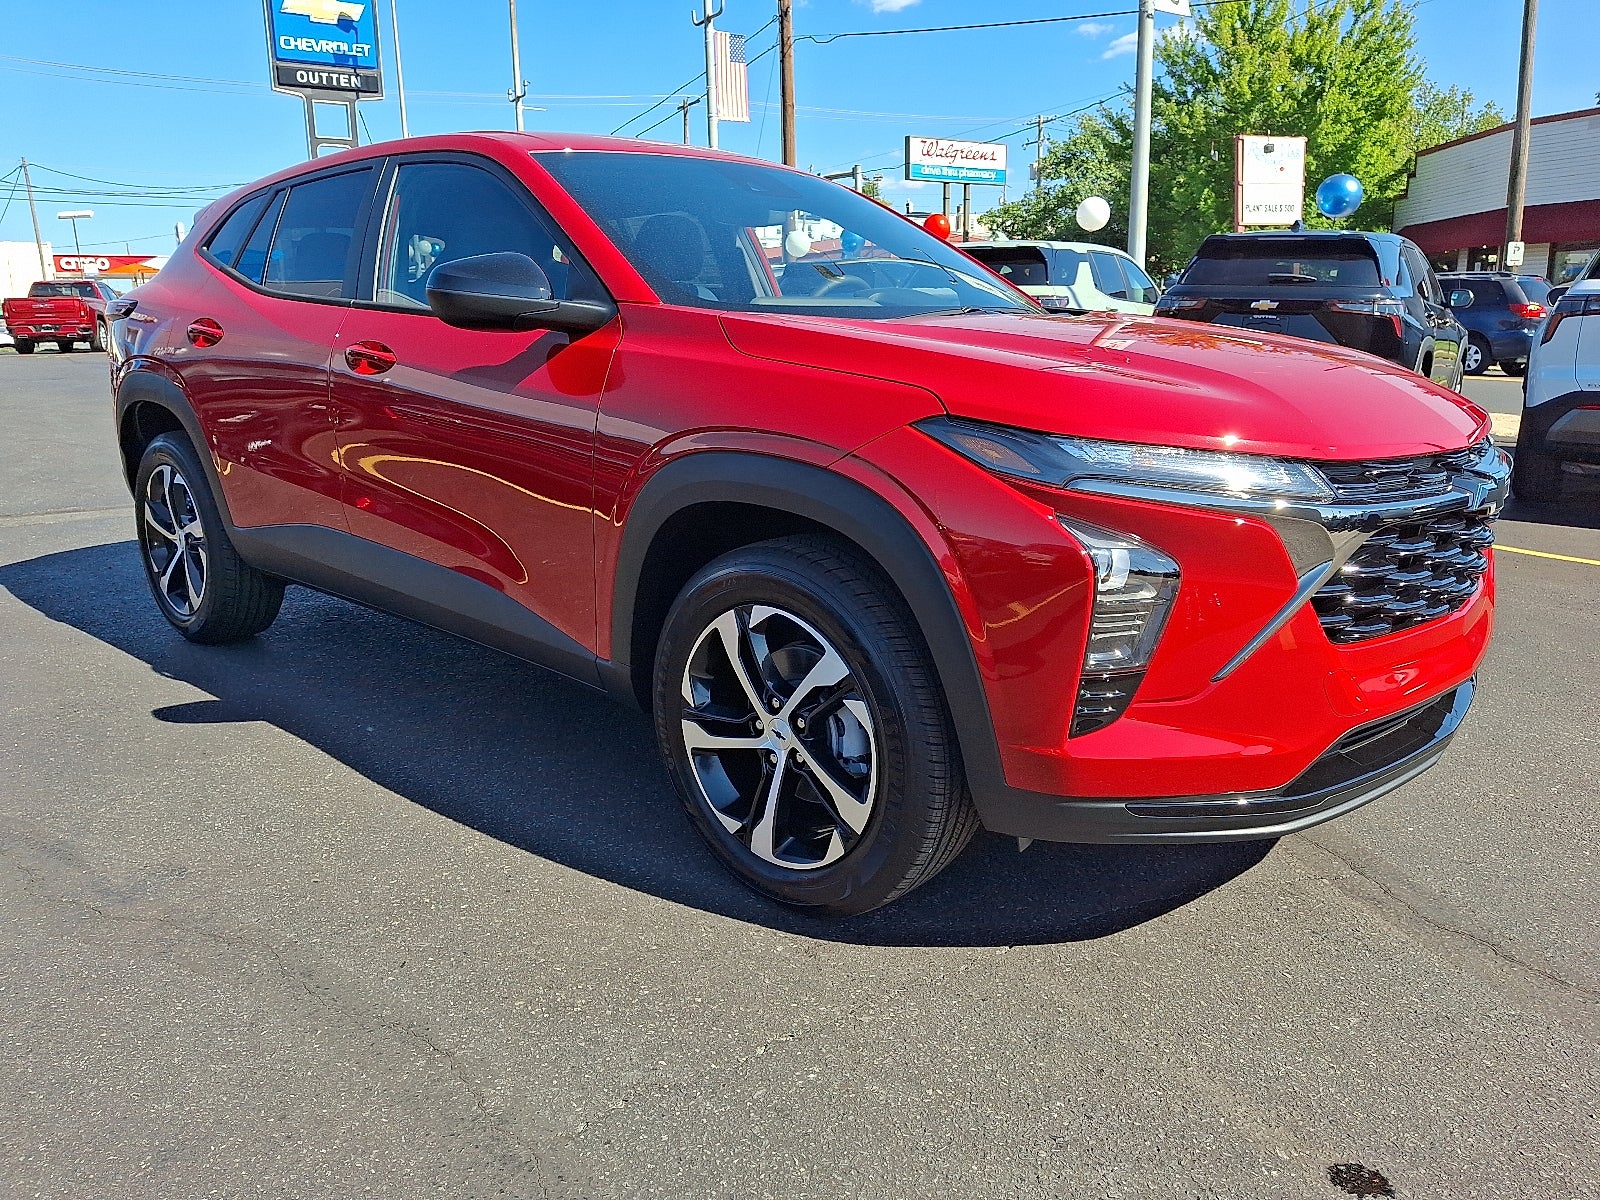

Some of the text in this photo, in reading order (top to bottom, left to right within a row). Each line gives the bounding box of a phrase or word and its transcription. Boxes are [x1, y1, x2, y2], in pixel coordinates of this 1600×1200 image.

[279, 35, 371, 57] CHEVROLET
[296, 70, 362, 88] OUTTEN
[920, 139, 998, 165] Walgreens
[959, 167, 997, 181] pharmacy
[1245, 204, 1262, 213] PLANT
[1264, 204, 1278, 213] SALE
